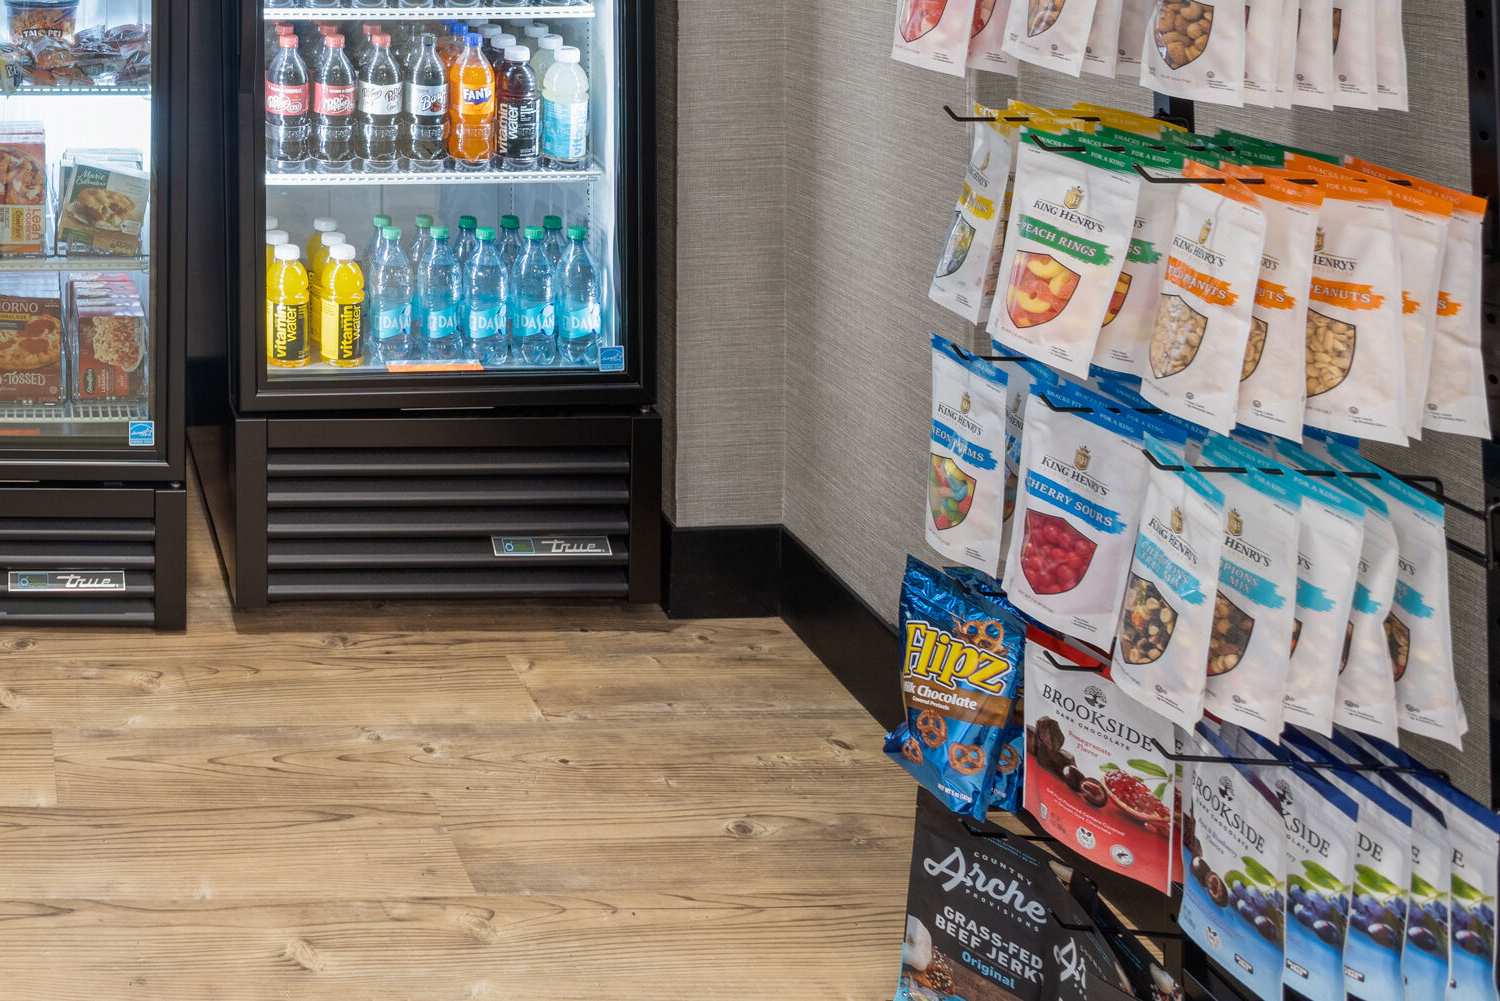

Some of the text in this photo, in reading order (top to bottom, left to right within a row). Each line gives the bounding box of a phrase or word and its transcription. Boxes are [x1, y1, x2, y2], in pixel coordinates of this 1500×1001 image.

[47, 29, 62, 37] PEI
[498, 102, 508, 154] vitamin
[509, 104, 518, 140] water
[1033, 200, 1105, 233] KING HENRY'S
[1022, 222, 1097, 257] PEACH RINGS
[1173, 235, 1226, 268] KING HENRY'S
[274, 304, 287, 358] vitamin
[287, 306, 299, 342] water
[341, 305, 353, 359] vitamin
[353, 305, 361, 342] water
[937, 403, 983, 436] KING HENRY'S
[1041, 455, 1108, 496] KING HENRY'S
[1256, 458, 1270, 468] FIT
[1027, 476, 1113, 527] CHERRY SOURS
[1293, 475, 1342, 504] FOR A KING
[541, 539, 602, 553] true
[1149, 518, 1198, 565] KING HENRY'S
[1225, 536, 1272, 568] HENRY'S
[57, 574, 116, 588] true
[1228, 574, 1251, 595] MIX
[904, 621, 1011, 694] Flipz
[912, 696, 950, 711] Covered Pretzels
[917, 684, 977, 711] Chocolate
[1042, 683, 1153, 753] BROOKSIDE
[1056, 709, 1131, 751] DARK CHOCOLATE
[1068, 731, 1111, 757] Pomegranate
[1076, 744, 1099, 758] Flavor
[974, 851, 1033, 886] COUNTRY
[965, 888, 1040, 933] PROVISIONS
[935, 913, 982, 950] BEEF
[943, 905, 1044, 970] GRASS-FED
[962, 950, 1016, 991] Original
